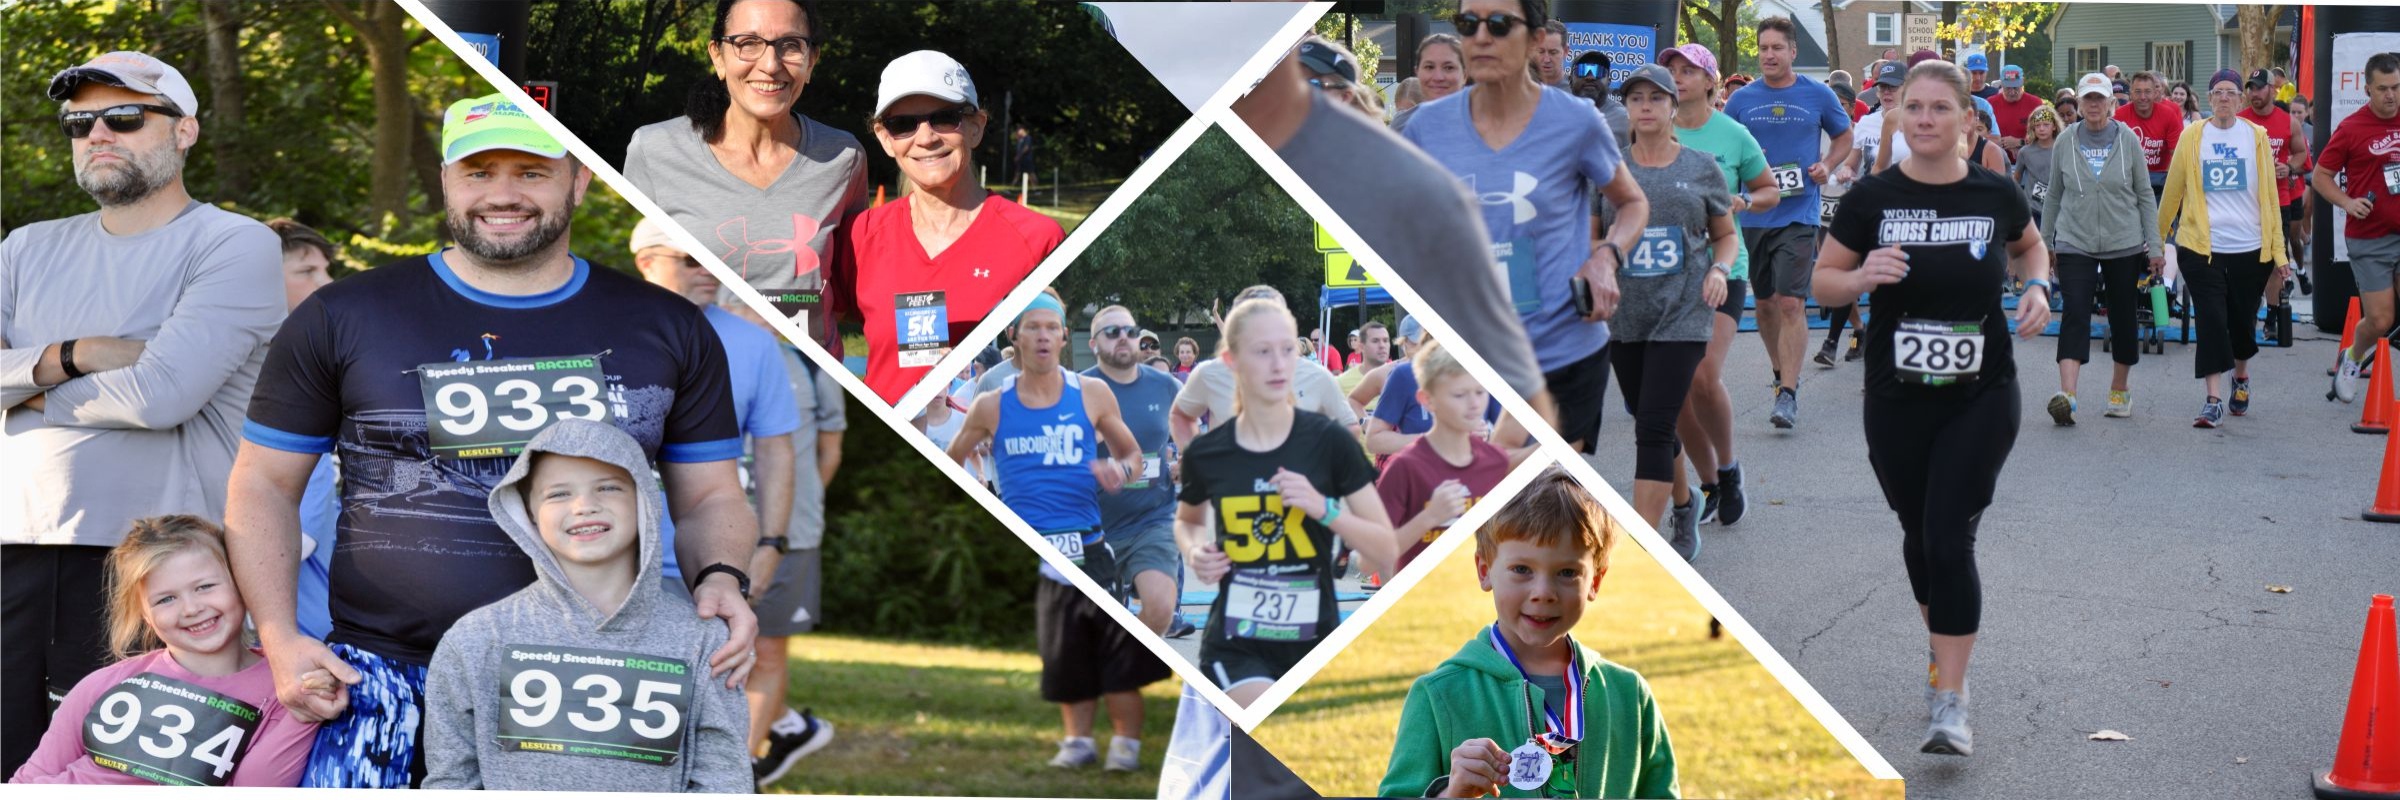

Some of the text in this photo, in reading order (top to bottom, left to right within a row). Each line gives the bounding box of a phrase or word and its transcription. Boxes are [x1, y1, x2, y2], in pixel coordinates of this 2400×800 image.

[1907, 26, 1934, 34] SCHOOL
[1914, 17, 1929, 25] END
[1567, 31, 1649, 49] THANK YOU
[1910, 35, 1932, 44] SPEED
[2144, 136, 2164, 147] Team
[2212, 143, 2238, 159] WK
[2372, 134, 2392, 150] GARY
[2144, 155, 2161, 165] Sole
[2209, 167, 2239, 186] 92
[1883, 209, 1938, 219] WOLVES
[1883, 220, 1990, 242] CROSS COUNTRY
[782, 294, 820, 303] RACING
[906, 294, 927, 303] FLEET
[908, 300, 926, 308] FEET
[907, 315, 937, 337] 5K
[1902, 335, 1976, 371] 289
[427, 358, 594, 380] Speedy Sneakers RACING
[435, 375, 607, 437] 933
[458, 447, 505, 458] RESULTS
[1004, 423, 1084, 466] KILBOURNE XC
[1220, 494, 1318, 563] 5K
[1252, 591, 1298, 622] 237
[511, 650, 686, 675] Speedy Sneakers RACING
[150, 680, 207, 704] Sneakers
[206, 695, 257, 722] RACING
[509, 668, 682, 740] 935
[91, 691, 246, 779] 934
[520, 741, 663, 762] RESULTS speedysneakers.com
[94, 755, 128, 771] RESULTS
[1512, 758, 1545, 779] 5K
